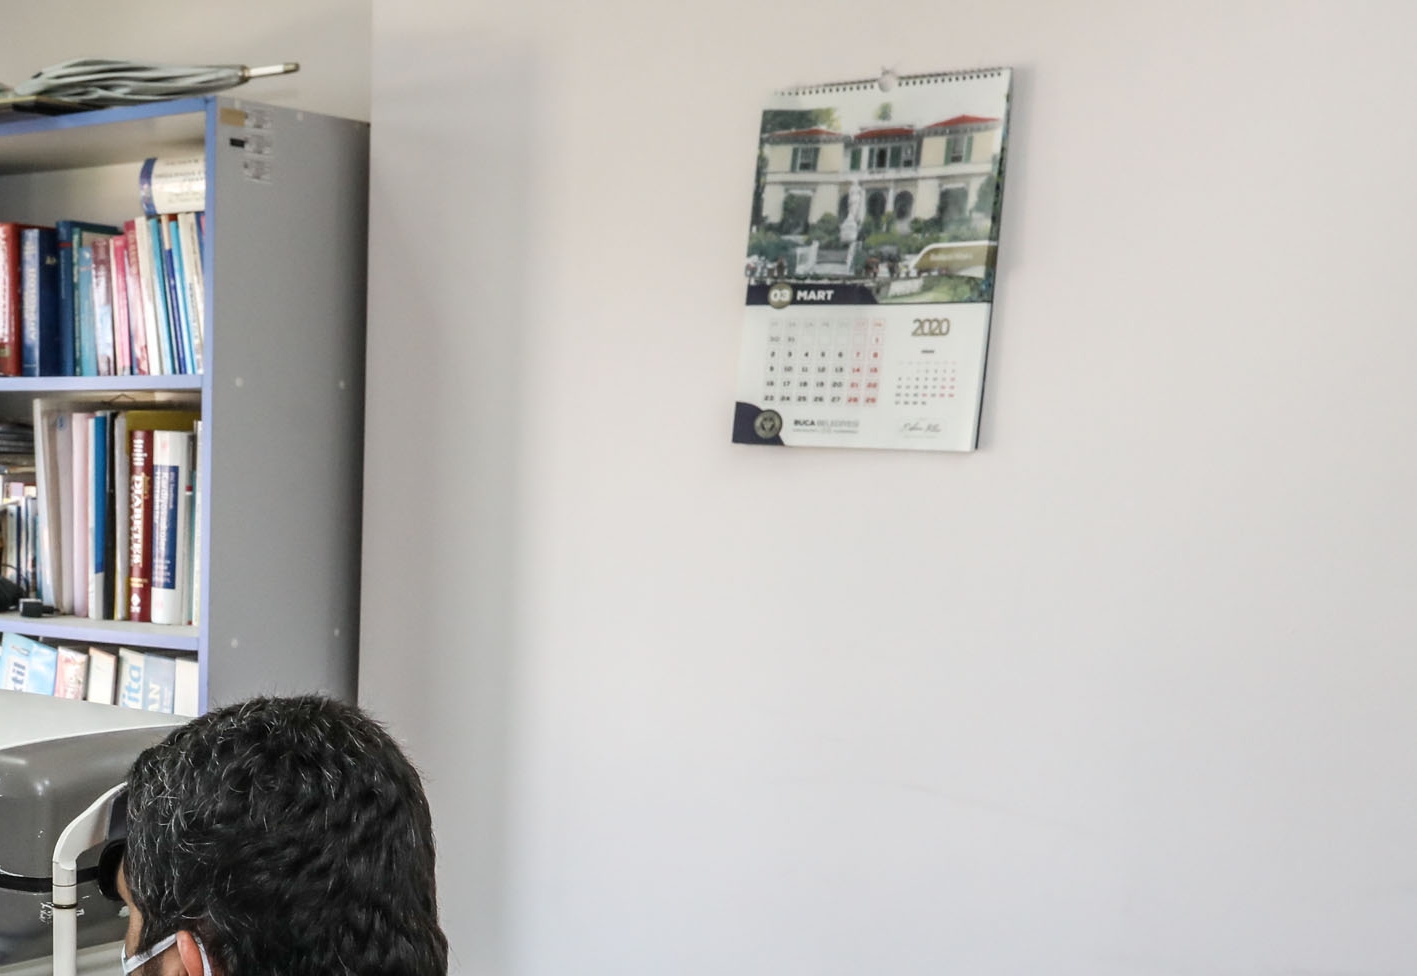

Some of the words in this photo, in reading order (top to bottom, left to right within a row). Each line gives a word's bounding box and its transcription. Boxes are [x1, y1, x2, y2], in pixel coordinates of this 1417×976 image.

[770, 289, 790, 301] 03
[796, 289, 835, 301] MART
[911, 318, 950, 336] 2020
[794, 419, 815, 427] BUCA
